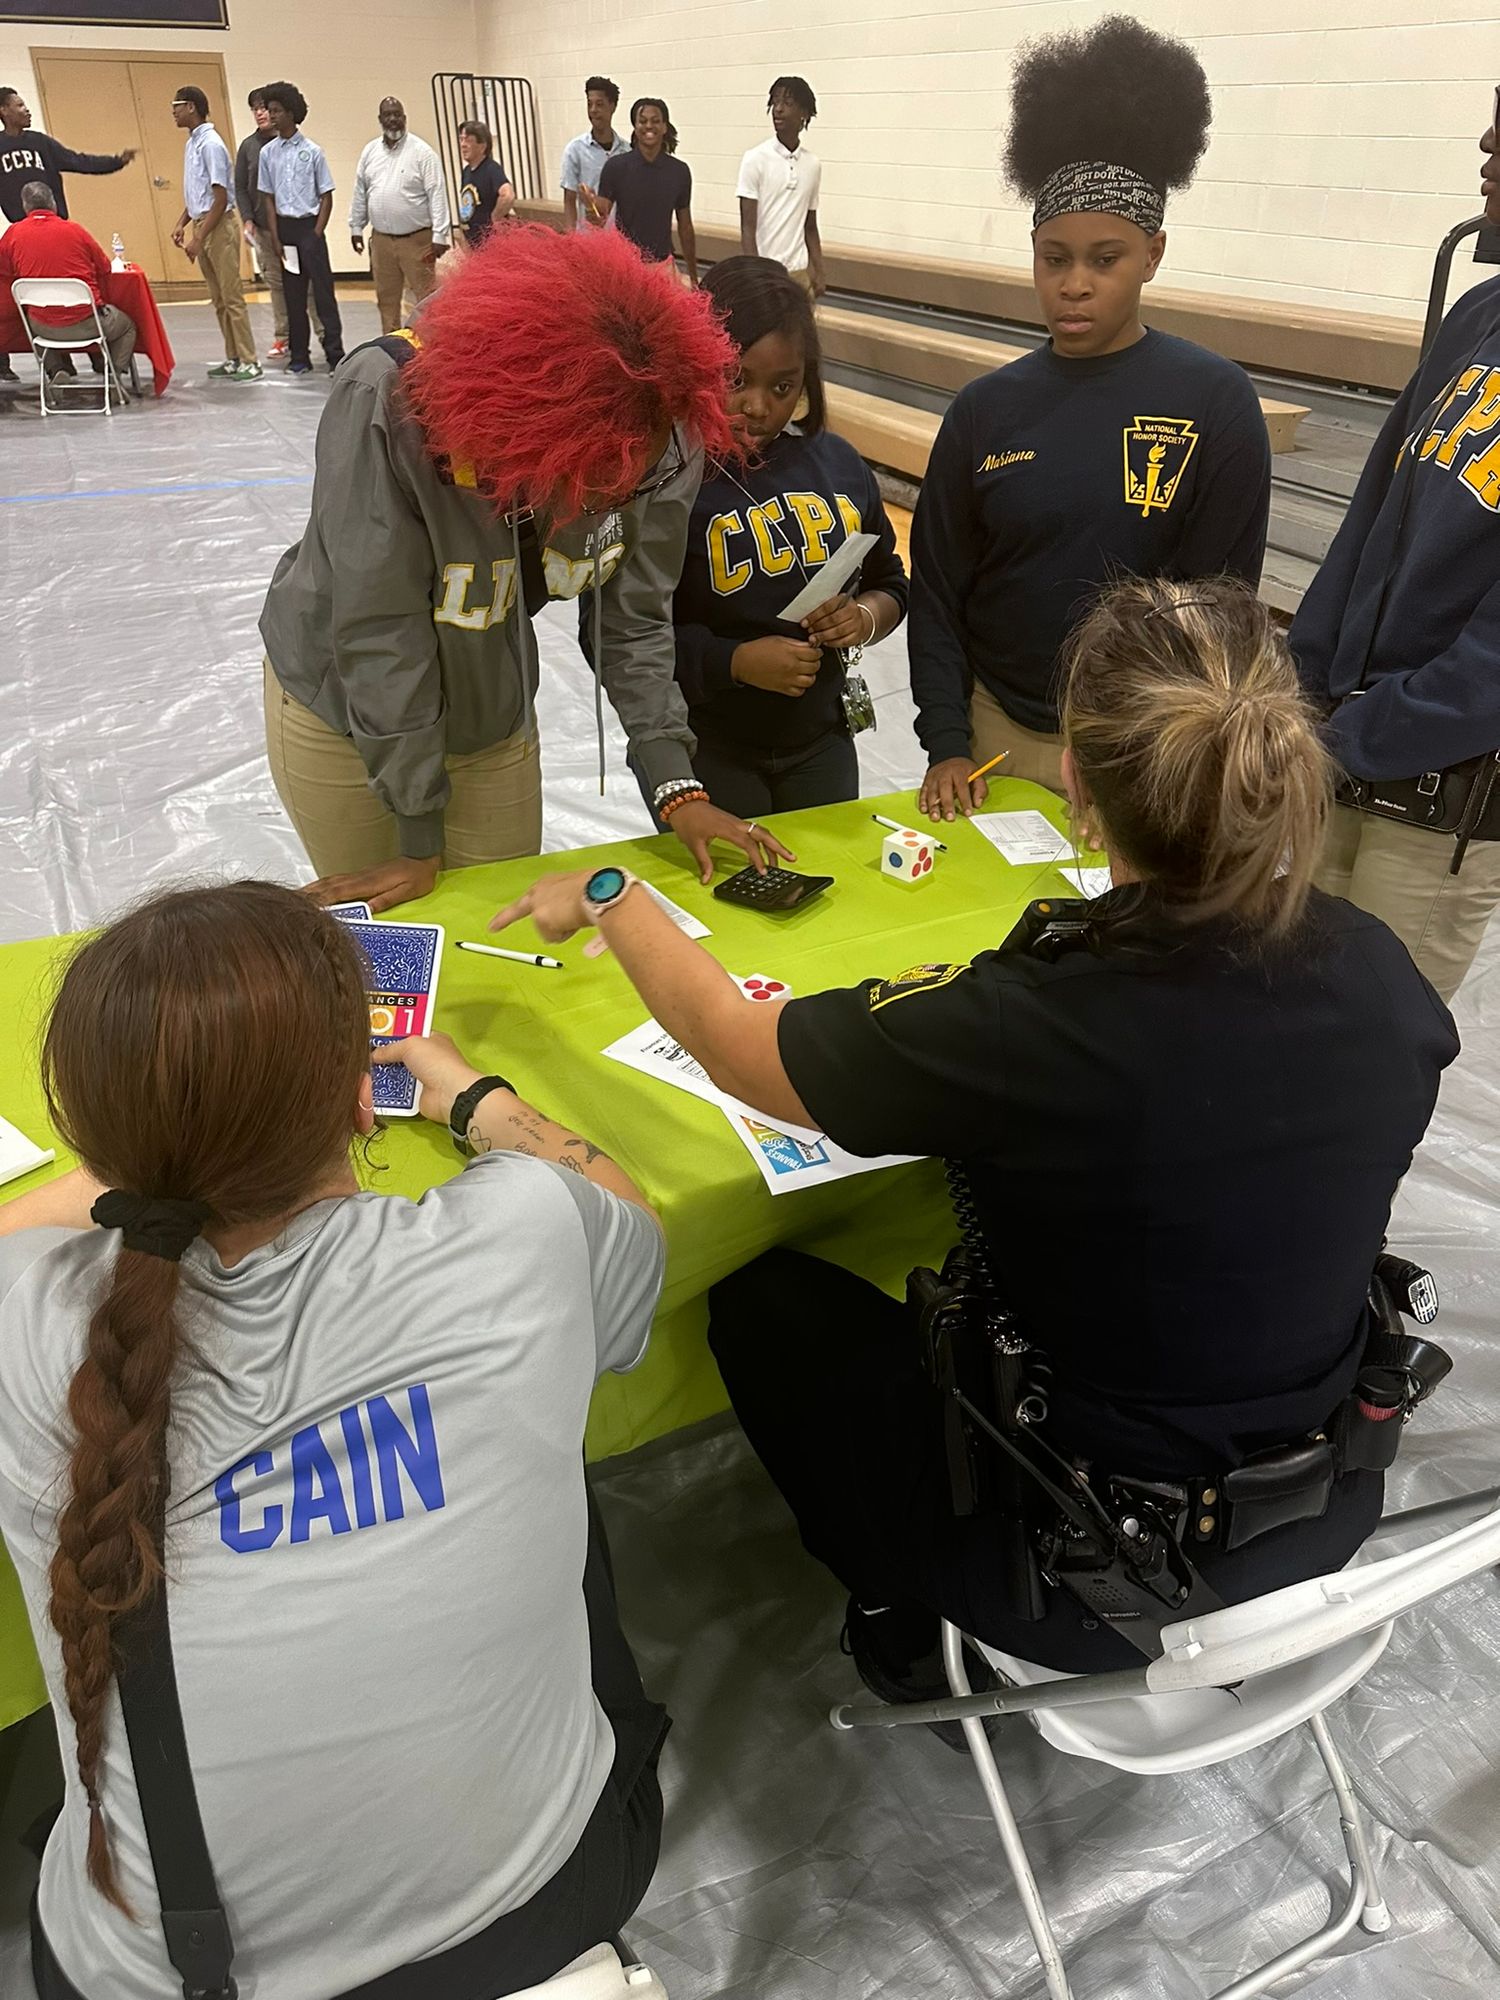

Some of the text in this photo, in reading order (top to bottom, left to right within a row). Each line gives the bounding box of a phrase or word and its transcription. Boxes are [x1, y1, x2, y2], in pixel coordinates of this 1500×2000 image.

[2, 150, 45, 173] CCPA
[1073, 171, 1093, 183] JUST
[1093, 171, 1108, 180] DO
[1070, 194, 1090, 206] JUST
[1144, 424, 1178, 435] NATIONAL
[1132, 432, 1187, 445] HONOR SOCIETY
[976, 450, 1037, 473] Mariana
[213, 1383, 447, 1554] CAIN
